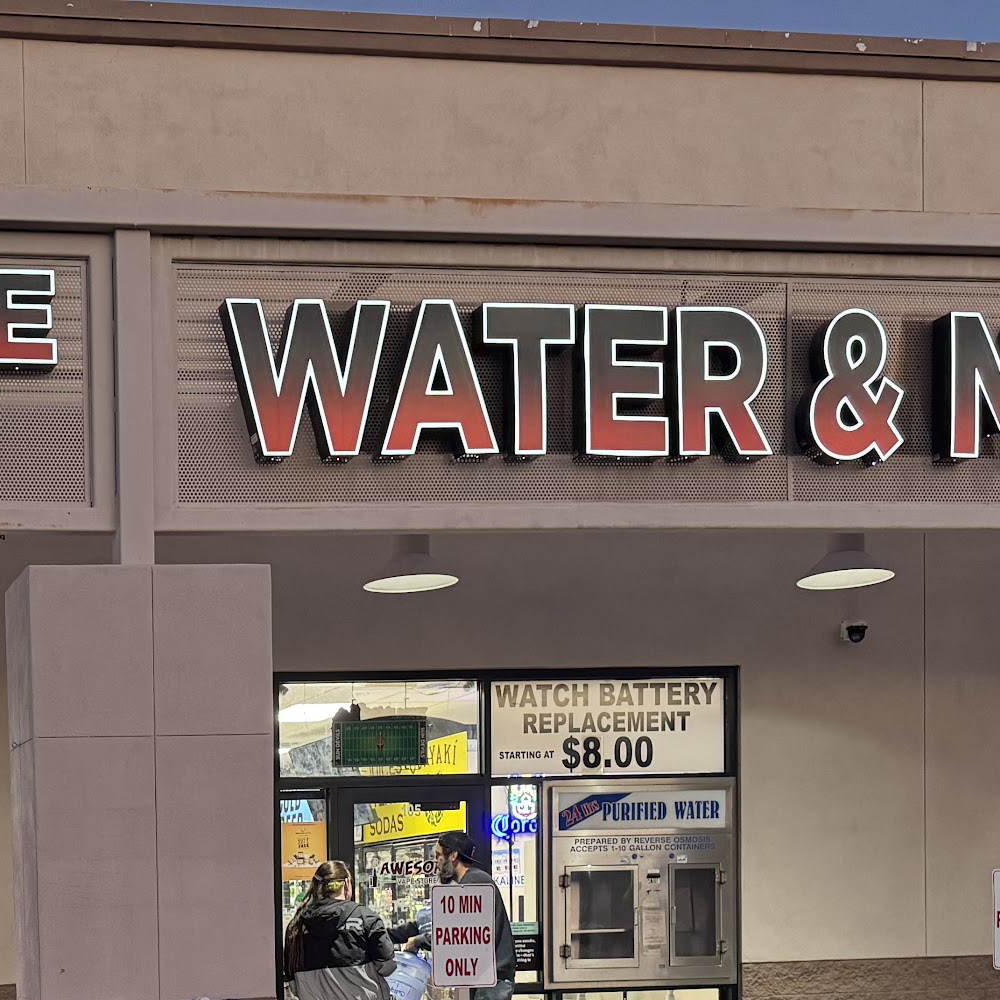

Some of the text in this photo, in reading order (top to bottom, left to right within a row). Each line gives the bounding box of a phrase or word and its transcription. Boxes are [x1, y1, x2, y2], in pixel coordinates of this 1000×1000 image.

[225, 298, 772, 457] WATER
[809, 308, 904, 462] &
[495, 682, 718, 708] WATCH BATTERY
[523, 711, 691, 734] REPLACEMENT
[499, 735, 654, 773] STARTING AT $8.00
[402, 804, 421, 817] 105
[562, 805, 582, 826] 24
[602, 800, 719, 821] PURIFIED WATER
[370, 814, 404, 836] SODAS
[570, 845, 608, 853] ACCEPTS
[664, 842, 715, 851] CONTAINERS
[440, 895, 482, 914] 10 MIN
[436, 926, 491, 945] PARKING
[445, 958, 478, 977] ONLY
